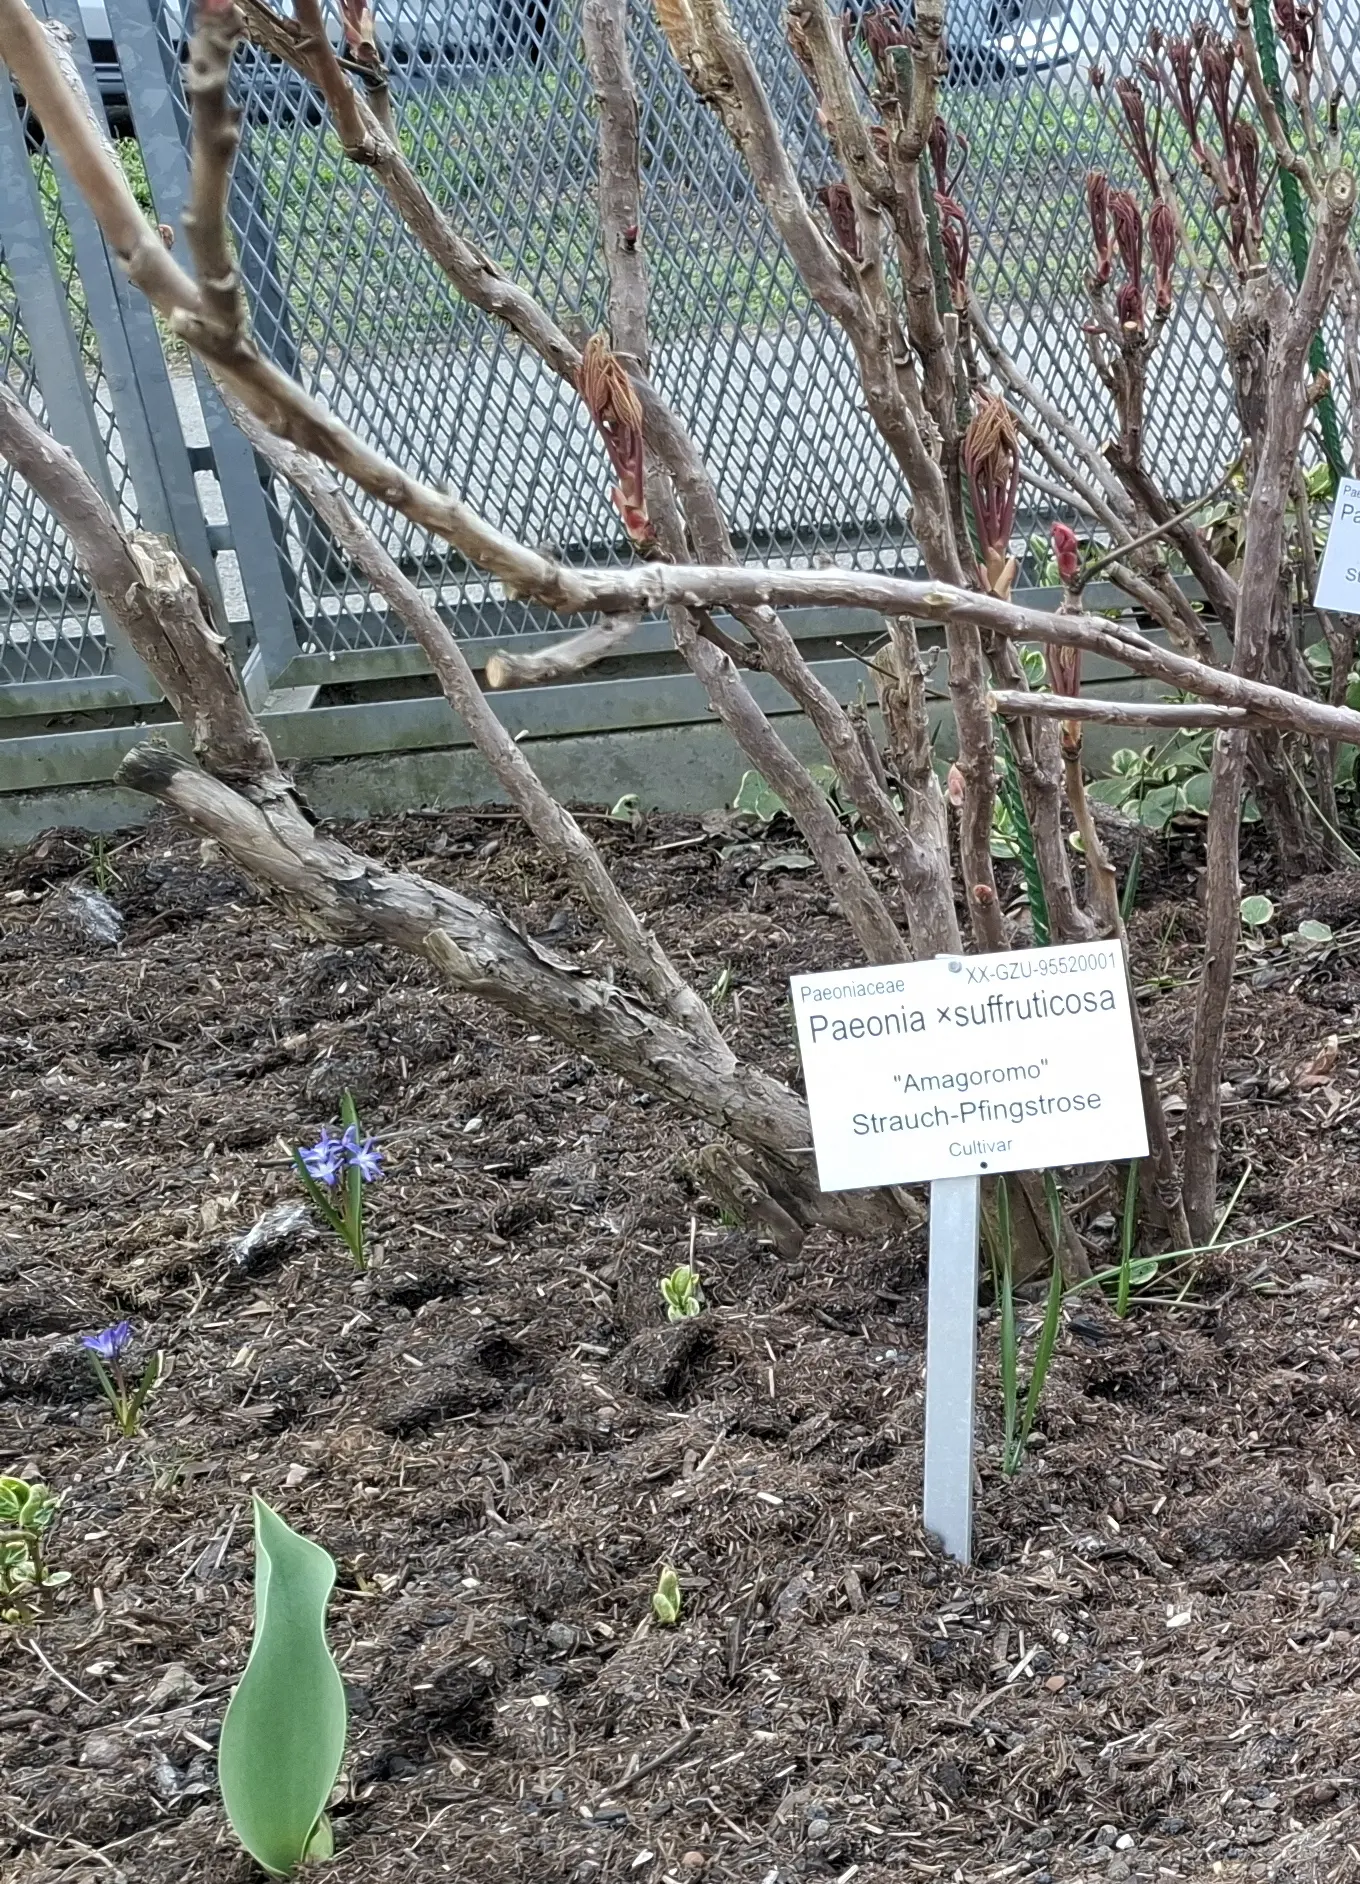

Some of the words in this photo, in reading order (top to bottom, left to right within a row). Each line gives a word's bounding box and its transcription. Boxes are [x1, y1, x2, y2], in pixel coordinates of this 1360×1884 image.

[966, 952, 1116, 985] XX-GZU-95520001
[800, 978, 905, 1003] Paeoniaceae
[809, 1006, 926, 1043] Paeonia
[893, 1058, 1049, 1094] "Amagoromo"
[852, 1092, 1102, 1136] Strauch-Pfingstrose
[948, 1139, 1013, 1157] Cultivar
